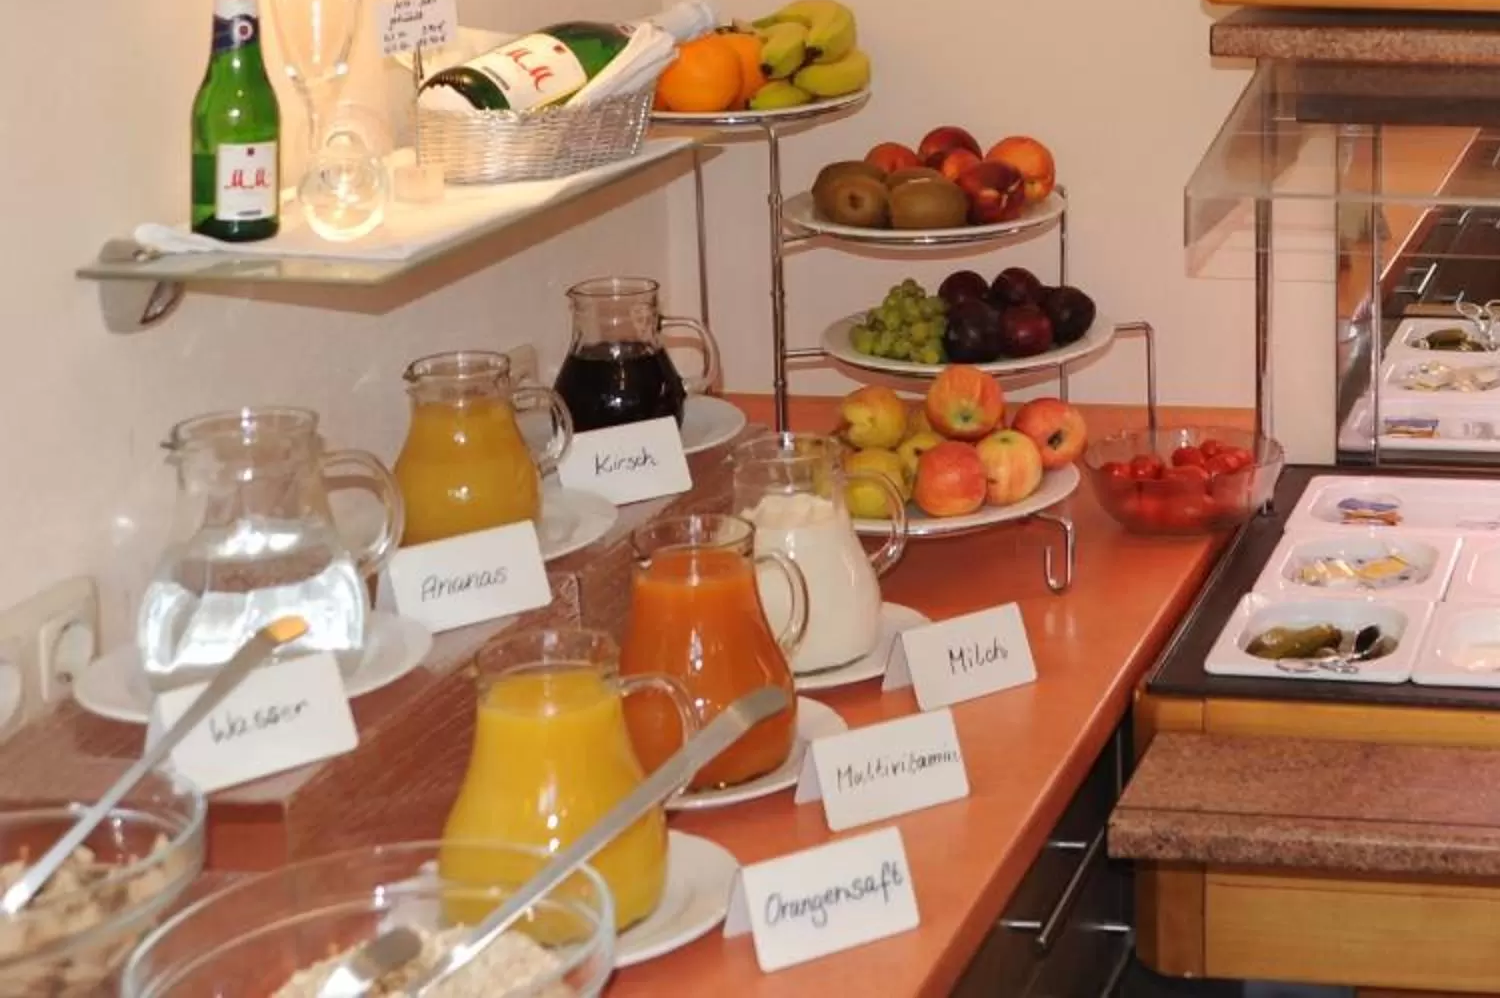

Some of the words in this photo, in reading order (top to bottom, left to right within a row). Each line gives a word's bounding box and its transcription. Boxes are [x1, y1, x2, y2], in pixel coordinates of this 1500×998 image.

[594, 451, 658, 476] Kirsch
[420, 566, 509, 602] Ananas
[947, 638, 1008, 675] Milch
[765, 861, 903, 926] Orangensaft
